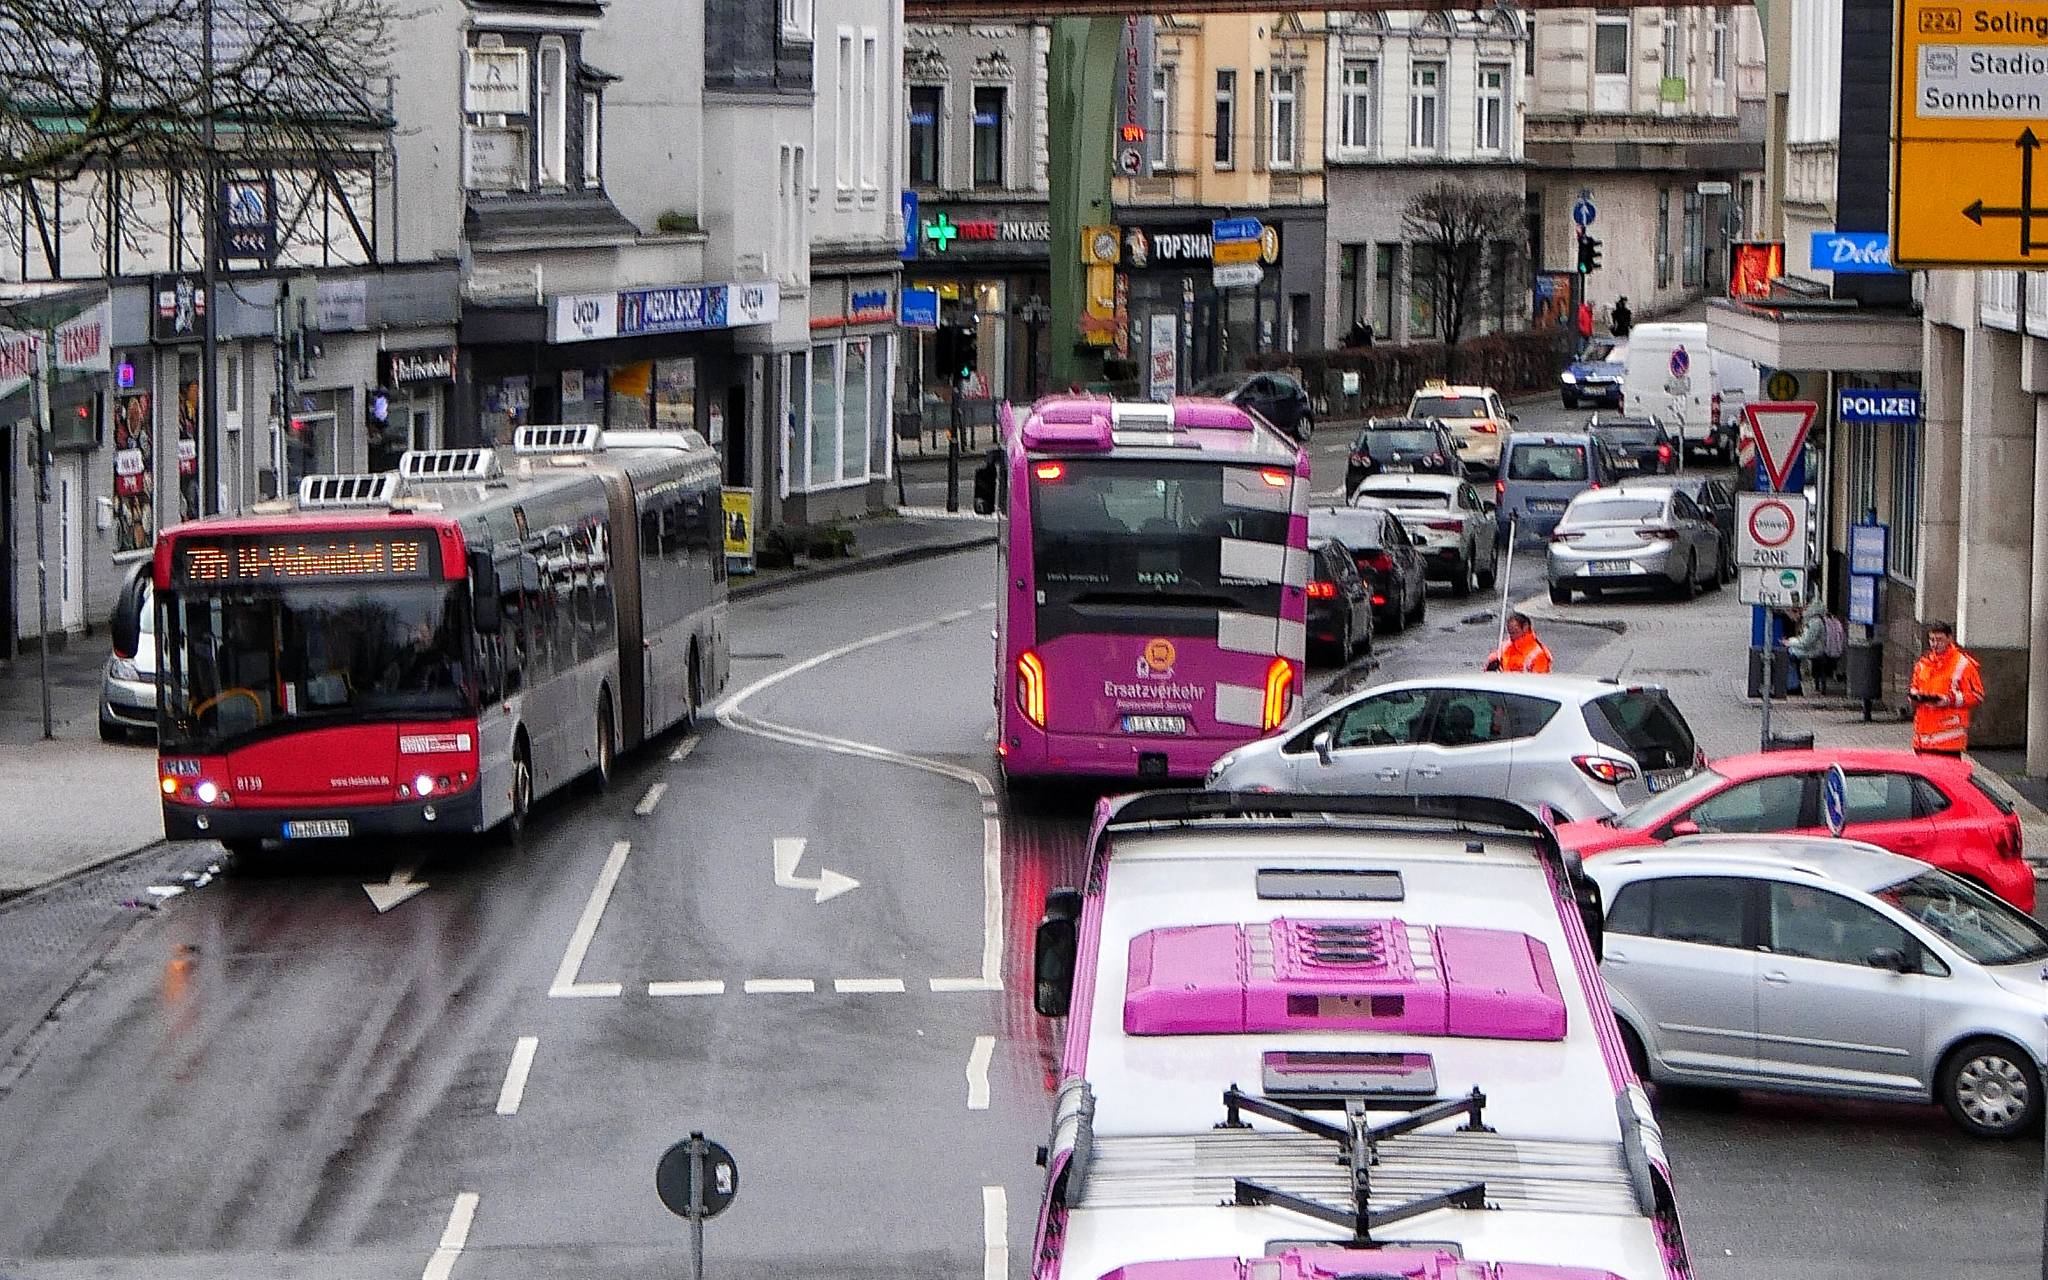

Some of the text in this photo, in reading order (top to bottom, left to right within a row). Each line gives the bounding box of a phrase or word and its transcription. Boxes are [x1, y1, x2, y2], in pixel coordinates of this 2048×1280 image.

[1923, 12, 1956, 30] 224
[1970, 51, 2048, 75] Stadio
[1926, 87, 2041, 111] Sonnborn
[1153, 234, 1181, 260] TOP
[1842, 395, 1917, 417] POLIZEI
[1753, 549, 1789, 564] ZONE
[1137, 571, 1180, 584] MAN
[1103, 680, 1206, 700] Ersatzverkehr
[237, 776, 262, 791] 8139
